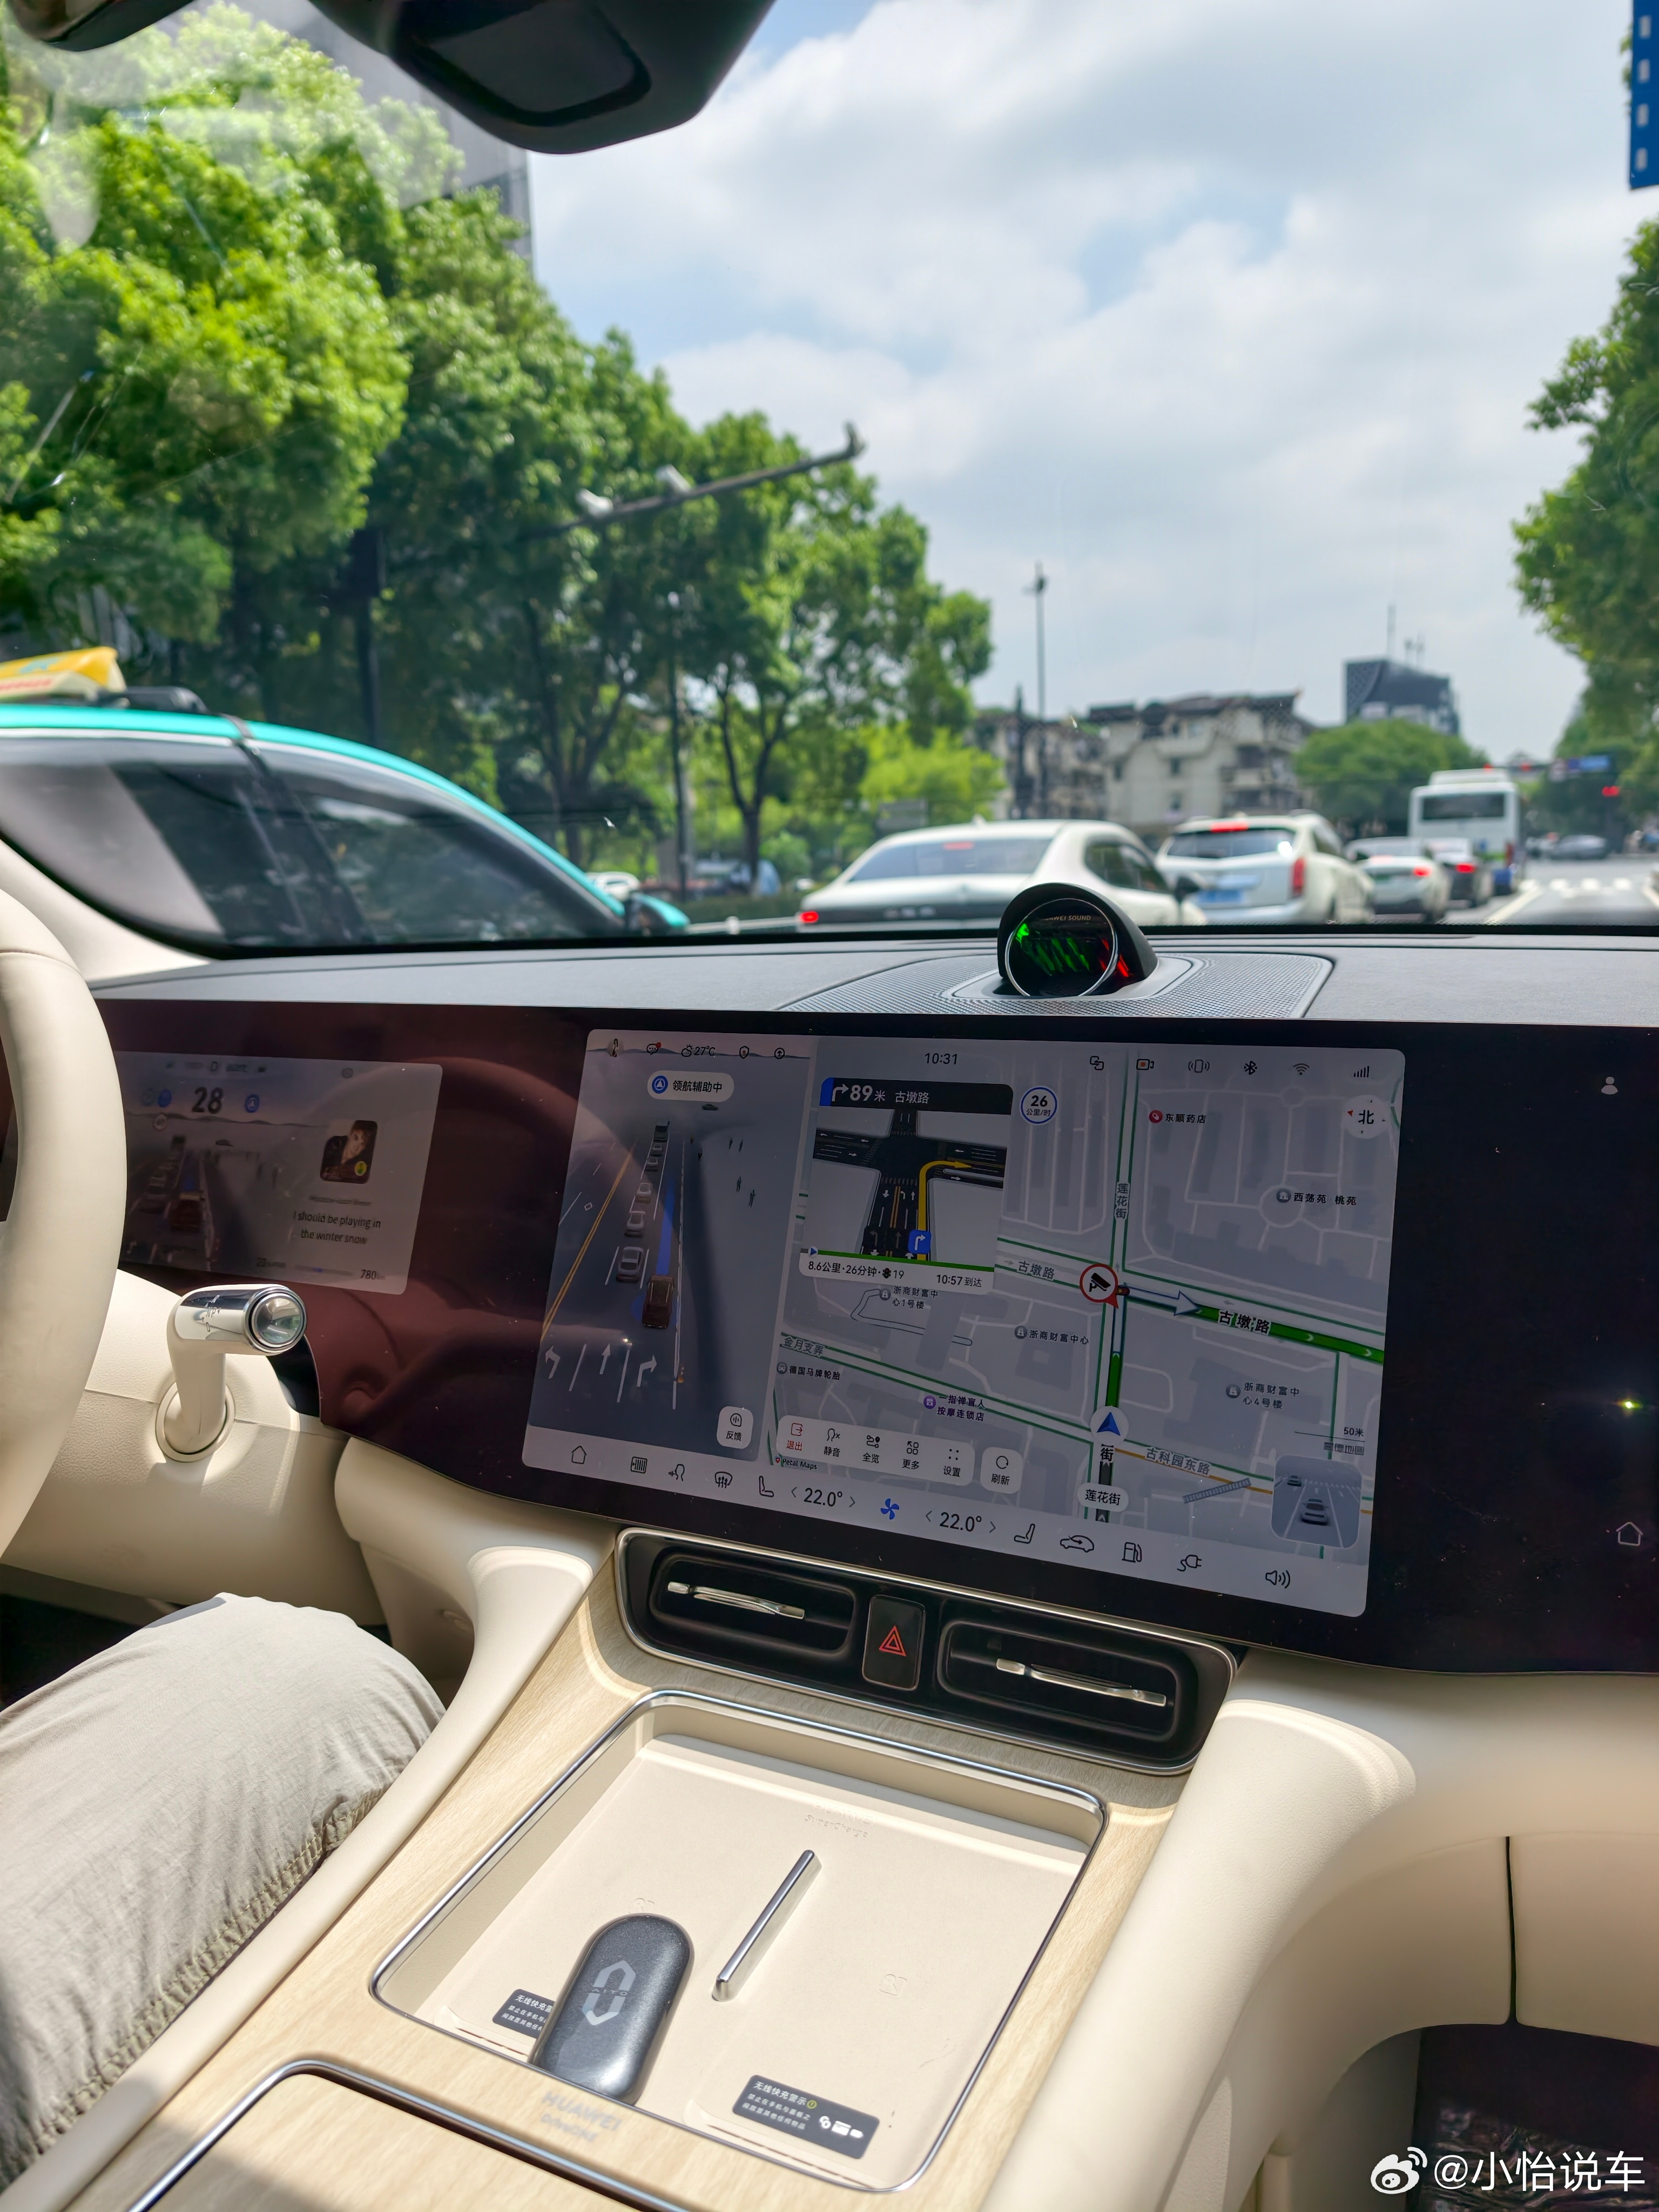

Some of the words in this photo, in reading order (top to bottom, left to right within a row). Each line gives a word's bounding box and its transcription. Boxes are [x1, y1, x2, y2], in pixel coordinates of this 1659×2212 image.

[694, 1046, 716, 1056] 27°C
[924, 1053, 958, 1065] 10:31
[672, 1080, 722, 1093] 领航辅助中
[191, 1087, 224, 1114] 28
[894, 1090, 929, 1104] 古墩路
[1030, 1095, 1048, 1108] 26
[1026, 1108, 1051, 1117] 公里/时
[1358, 1109, 1374, 1125] 北
[1115, 1183, 1129, 1219] 莲花街
[298, 1211, 326, 1223] should
[327, 1215, 339, 1224] be
[340, 1216, 371, 1230] playing
[373, 1218, 381, 1229] in
[301, 1229, 314, 1239] the
[316, 1232, 343, 1242] winter
[345, 1235, 368, 1245] snow
[360, 1270, 377, 1280] 780
[893, 1269, 904, 1279] 19
[1017, 1260, 1055, 1280] 古墩路
[936, 1273, 963, 1286] 10:57
[964, 1276, 982, 1287] 到达
[893, 1285, 938, 1298] 浙商财富中
[892, 1298, 925, 1310] 心1号楼
[1220, 1310, 1270, 1334] 古墩路
[1029, 1330, 1089, 1345] 浙商财富中心
[783, 1337, 824, 1356] 金月支弄
[789, 1365, 840, 1380] 德国马牌轮胎
[939, 1394, 986, 1408] 一指禅盲人
[937, 1406, 984, 1421] 按摩连锁店
[726, 1431, 742, 1441] 反馈
[1344, 1426, 1364, 1437] 50米
[786, 1440, 802, 1451] 退出
[824, 1446, 840, 1457] 静音
[783, 1458, 798, 1467] Petal
[800, 1461, 817, 1471] Maps
[862, 1452, 880, 1464] 全览
[902, 1459, 919, 1469] 更多
[943, 1466, 961, 1478] 设置
[991, 1473, 1010, 1486] 刷新
[804, 1487, 842, 1507] 22.0°
[1085, 1489, 1121, 1506] 莲花街
[940, 1512, 982, 1532] 22.0°
[592, 1988, 628, 1997] AITO
[753, 2081, 807, 2106] 无线快充警示
